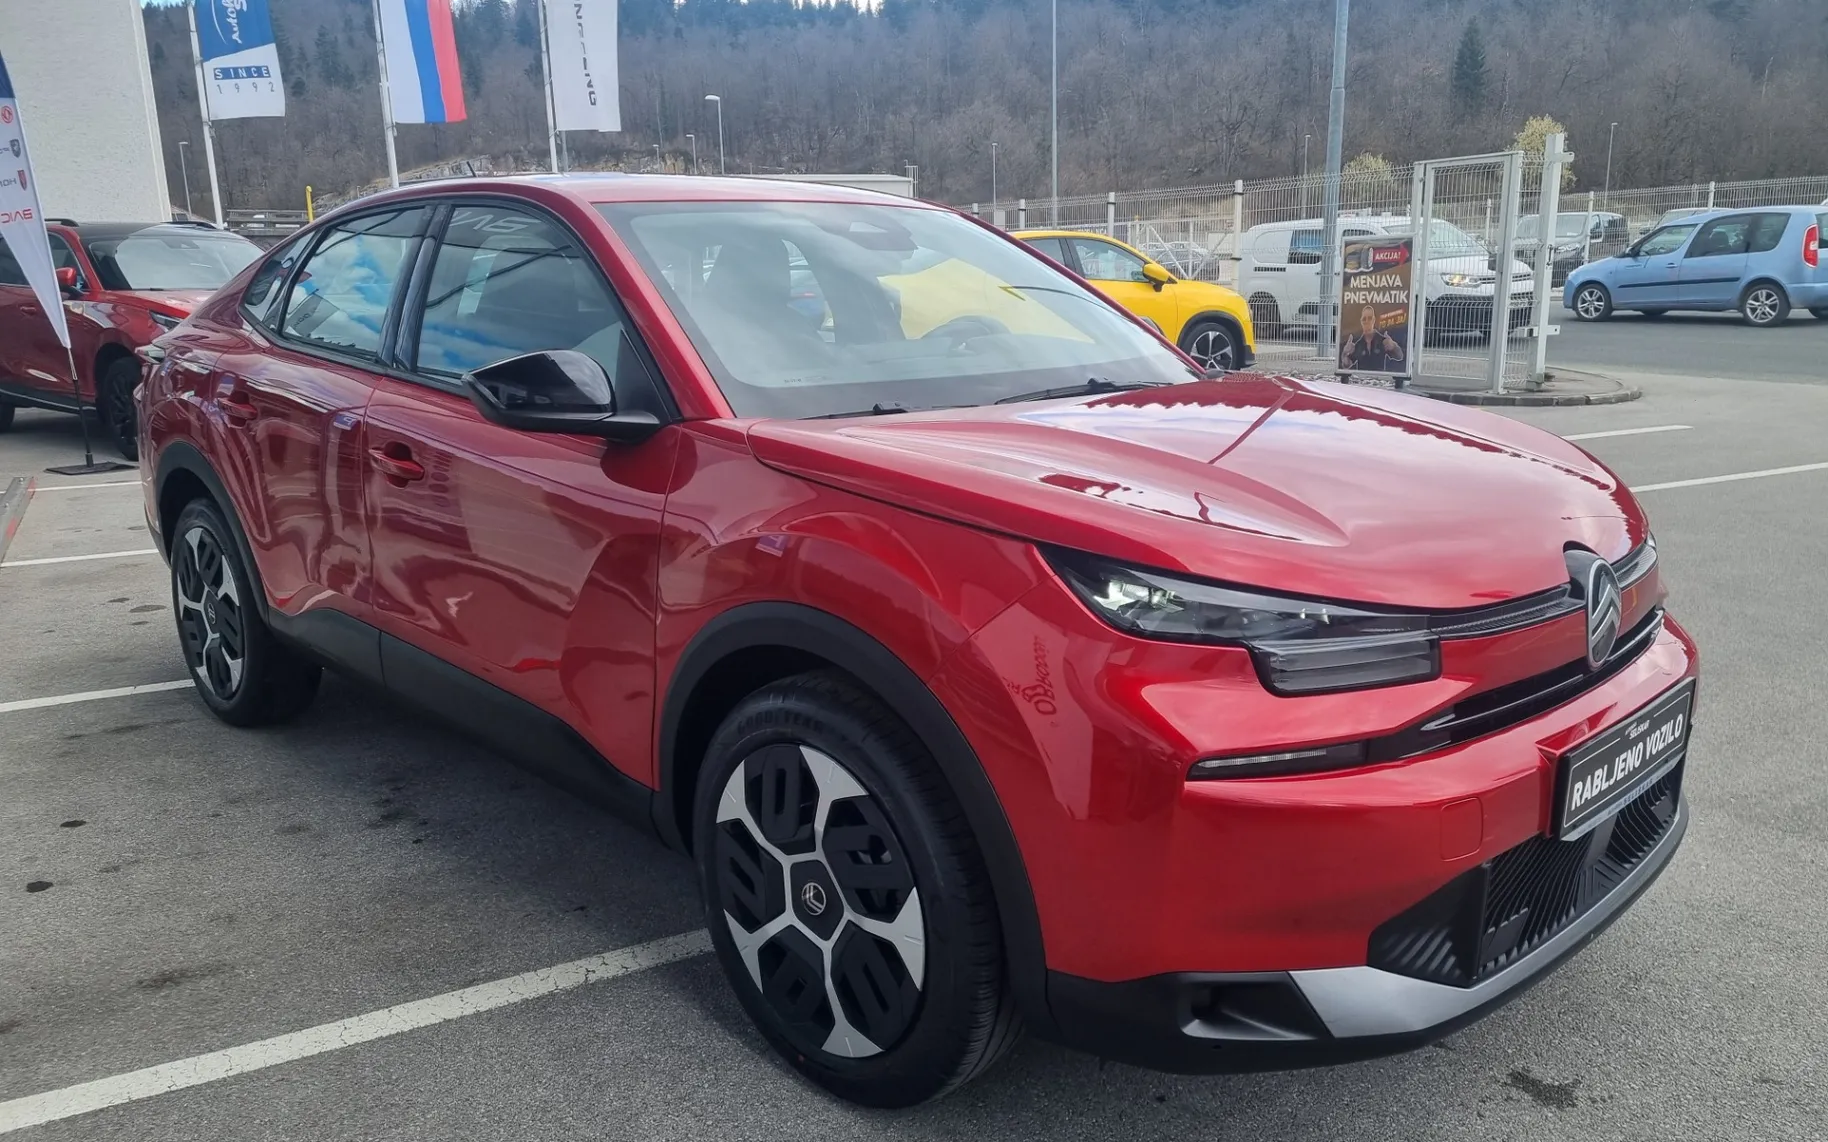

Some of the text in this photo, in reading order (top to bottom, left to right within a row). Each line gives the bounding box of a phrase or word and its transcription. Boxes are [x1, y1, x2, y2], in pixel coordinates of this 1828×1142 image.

[214, 66, 270, 79] SINCE
[216, 81, 275, 95] 1992
[1350, 275, 1403, 289] MENJAVA
[1344, 290, 1408, 304] PNEVMATIK
[1571, 713, 1684, 811] RABLJENO VOZILO
